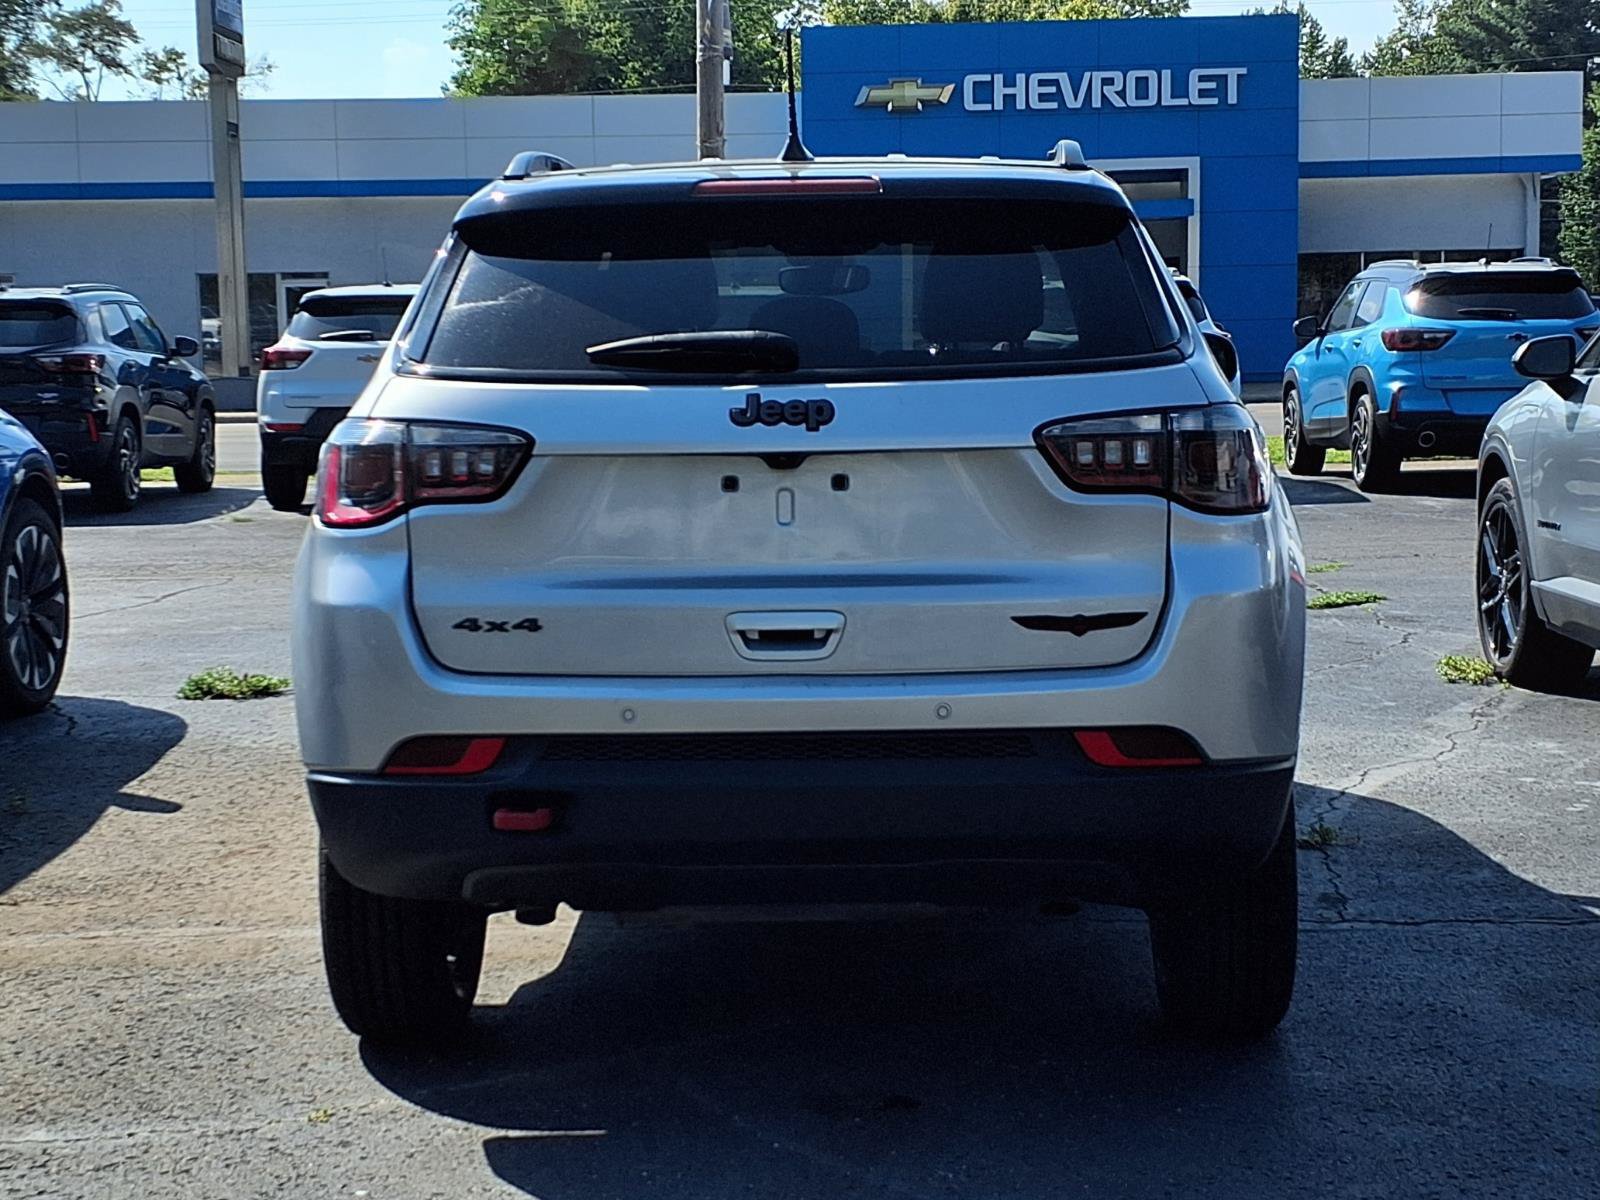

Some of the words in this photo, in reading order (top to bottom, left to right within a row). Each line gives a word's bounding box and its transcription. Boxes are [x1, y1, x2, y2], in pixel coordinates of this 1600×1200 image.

[963, 67, 1248, 112] CHEVROLET
[729, 392, 836, 432] Jeep
[451, 617, 543, 633] 4x4
